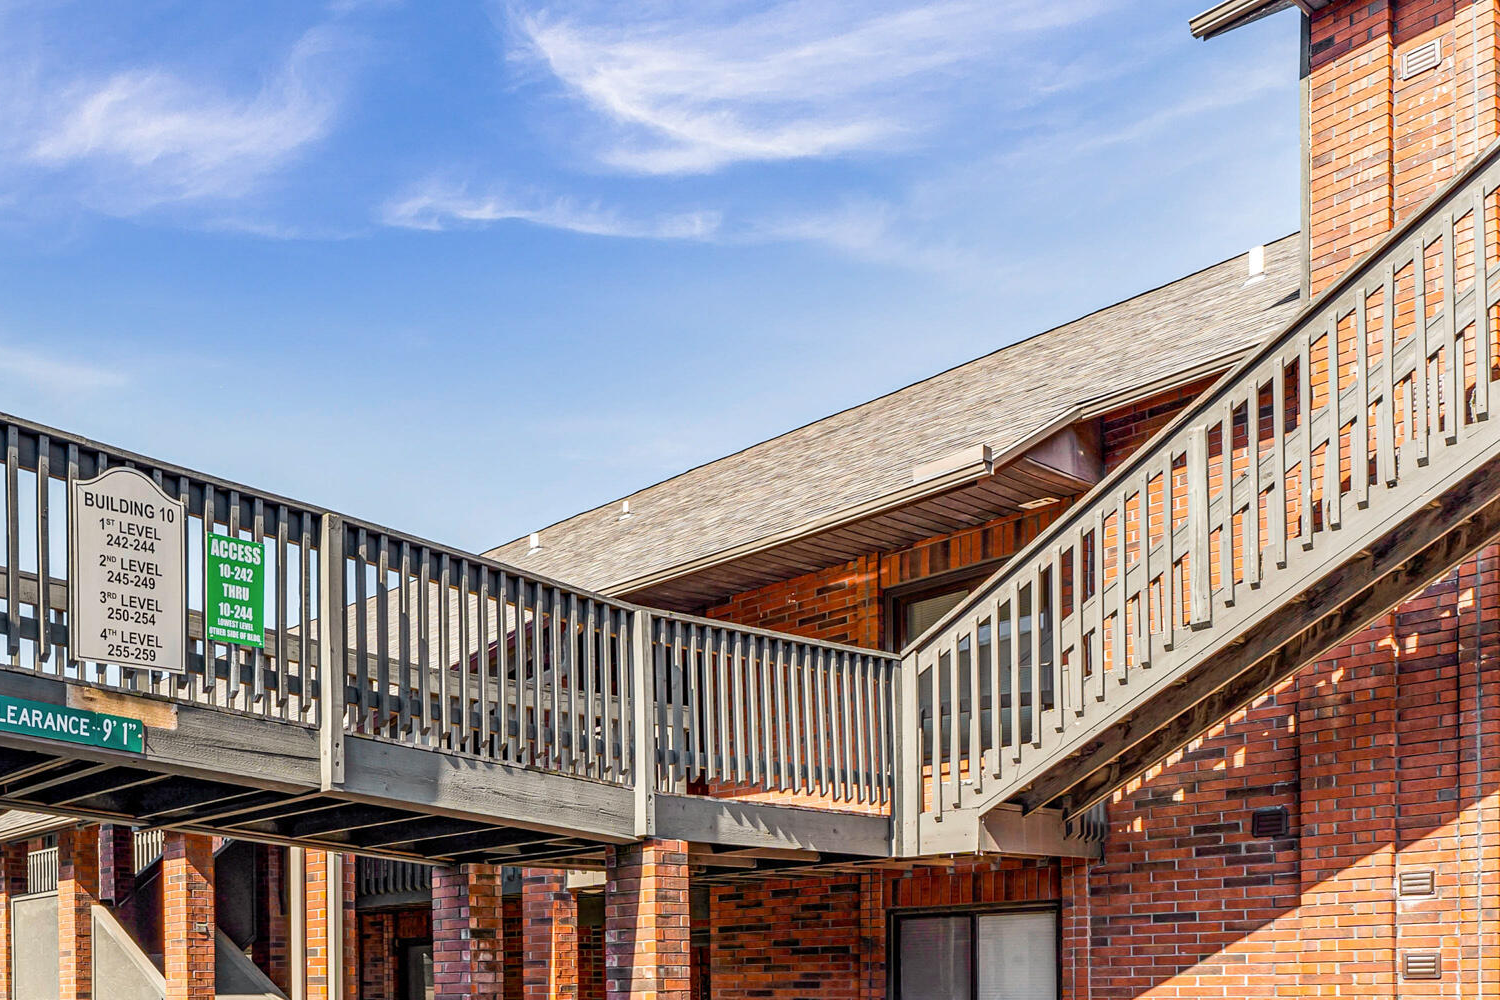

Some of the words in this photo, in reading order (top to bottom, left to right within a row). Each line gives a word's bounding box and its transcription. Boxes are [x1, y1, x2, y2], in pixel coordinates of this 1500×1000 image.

[84, 491, 155, 520] BUILDING
[159, 507, 175, 524] 10
[99, 517, 115, 530] 1ST
[119, 521, 161, 541] LEVEL
[106, 533, 156, 554] 242-244
[210, 538, 261, 565] ACCESS
[99, 554, 117, 567] 2ND
[120, 557, 163, 577] LEVEL
[218, 563, 254, 583] 10-242
[107, 570, 156, 590] 245-249
[99, 591, 117, 604] 3RD
[121, 594, 163, 613] LEVEL
[222, 583, 250, 602] THRU
[107, 607, 156, 626] 250-254
[218, 602, 254, 622] 10-244
[209, 626, 226, 636] OTHER
[217, 617, 238, 629] LOWEST
[239, 621, 254, 631] LEVEL
[100, 628, 117, 641] 4TH
[121, 631, 163, 649] LEVEL
[107, 644, 156, 662] 255-259
